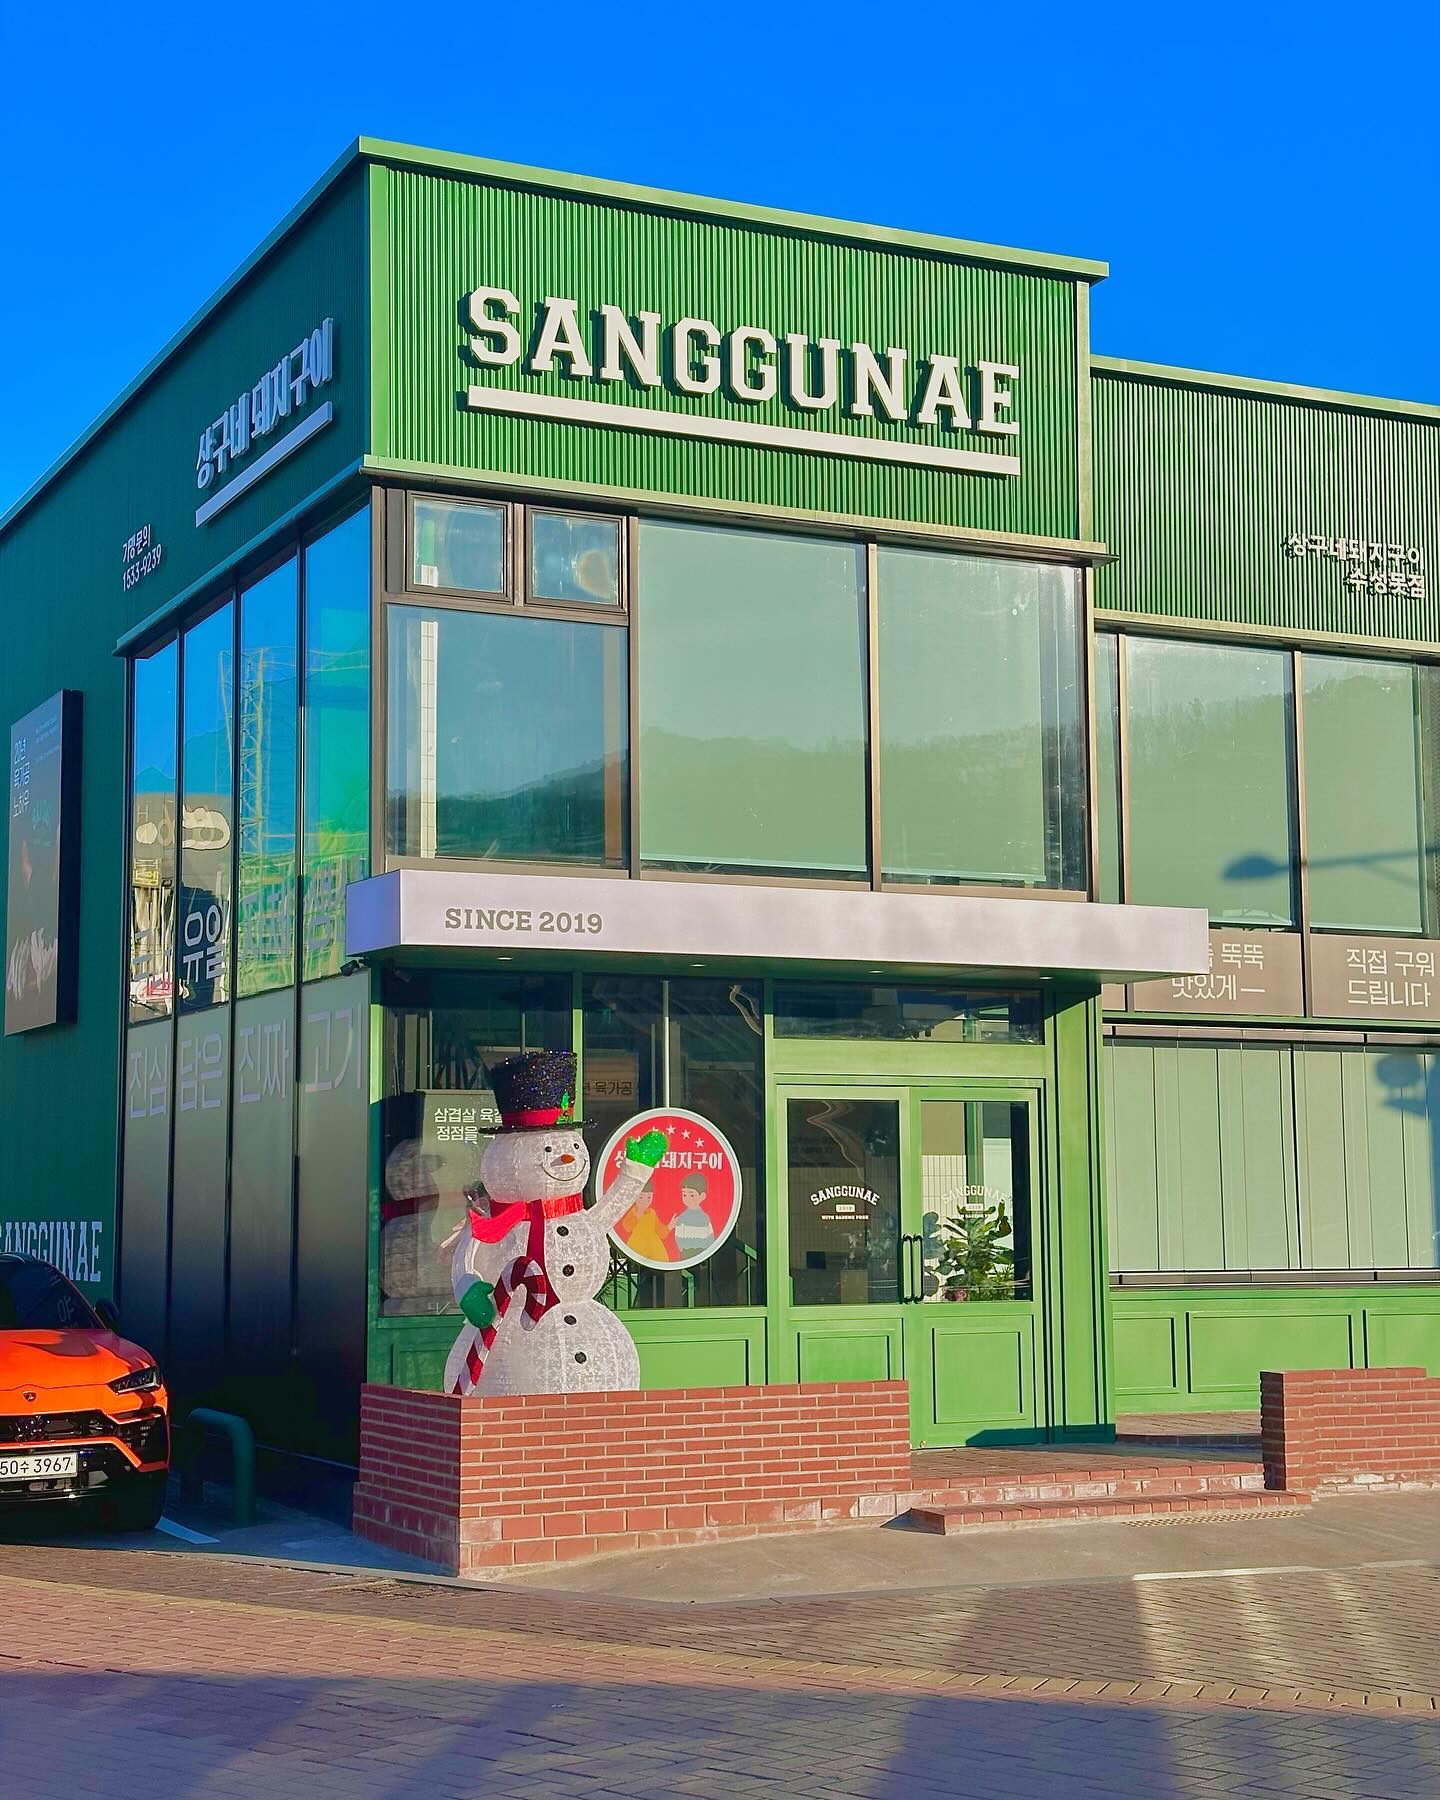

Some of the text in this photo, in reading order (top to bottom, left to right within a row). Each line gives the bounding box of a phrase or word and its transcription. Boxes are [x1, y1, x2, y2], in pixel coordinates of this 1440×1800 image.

[468, 285, 1021, 436] SANGGUNAE
[122, 523, 151, 564] 가맹문의
[1349, 567, 1426, 600] 수성못점
[444, 907, 603, 934] SINCE 2019
[1221, 942, 1265, 971] 뚝뚝
[1346, 947, 1436, 978] 직접 구워
[1347, 979, 1432, 1008] 드립니다
[129, 1002, 362, 1119] 진심 담은 진짜 고기
[434, 1107, 477, 1124] 삼겹살
[436, 1125, 479, 1142] 정점을
[810, 1185, 880, 1206] SANGGUNAE
[0, 1221, 103, 1283] ANGGUNAE
[33, 1456, 71, 1474] 3967
